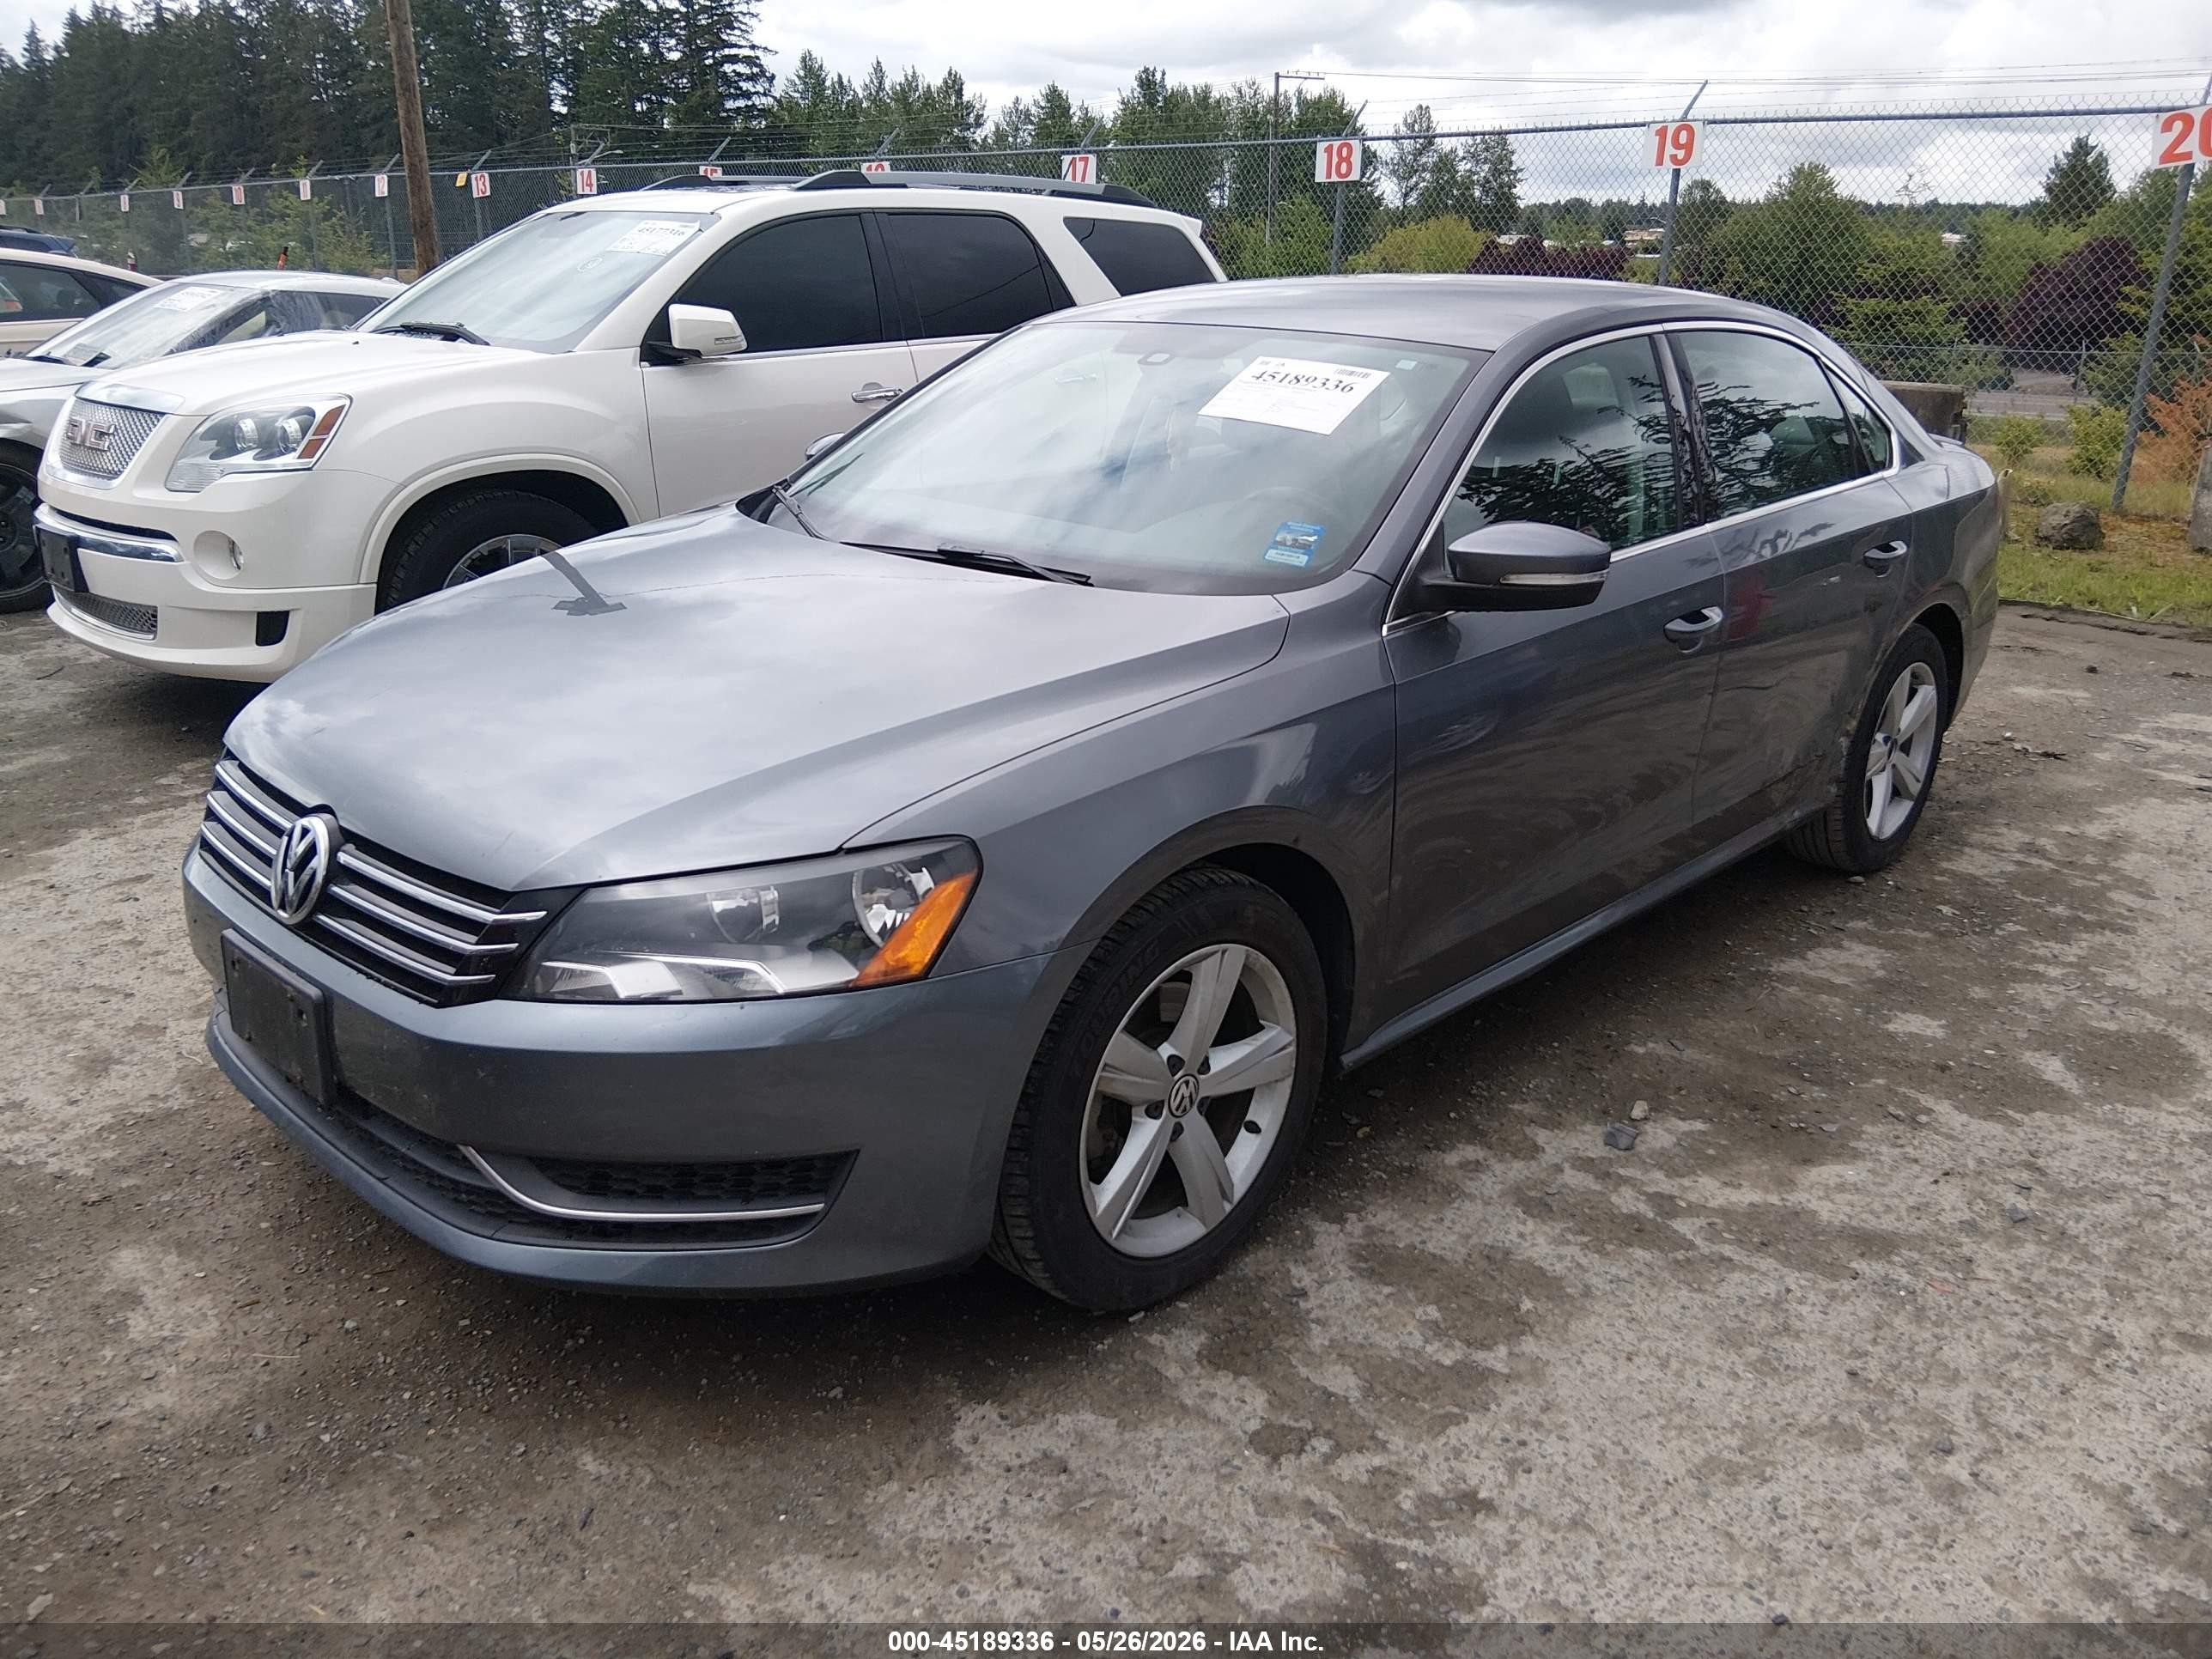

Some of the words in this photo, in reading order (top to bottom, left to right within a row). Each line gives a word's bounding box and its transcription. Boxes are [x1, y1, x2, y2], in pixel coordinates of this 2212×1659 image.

[1654, 124, 1695, 167] 19
[1071, 156, 1090, 183] 17
[1323, 142, 1353, 179] 18
[378, 176, 386, 196] 12
[474, 173, 487, 196] 13
[580, 169, 593, 192] 14
[1250, 370, 1355, 394] 45189336
